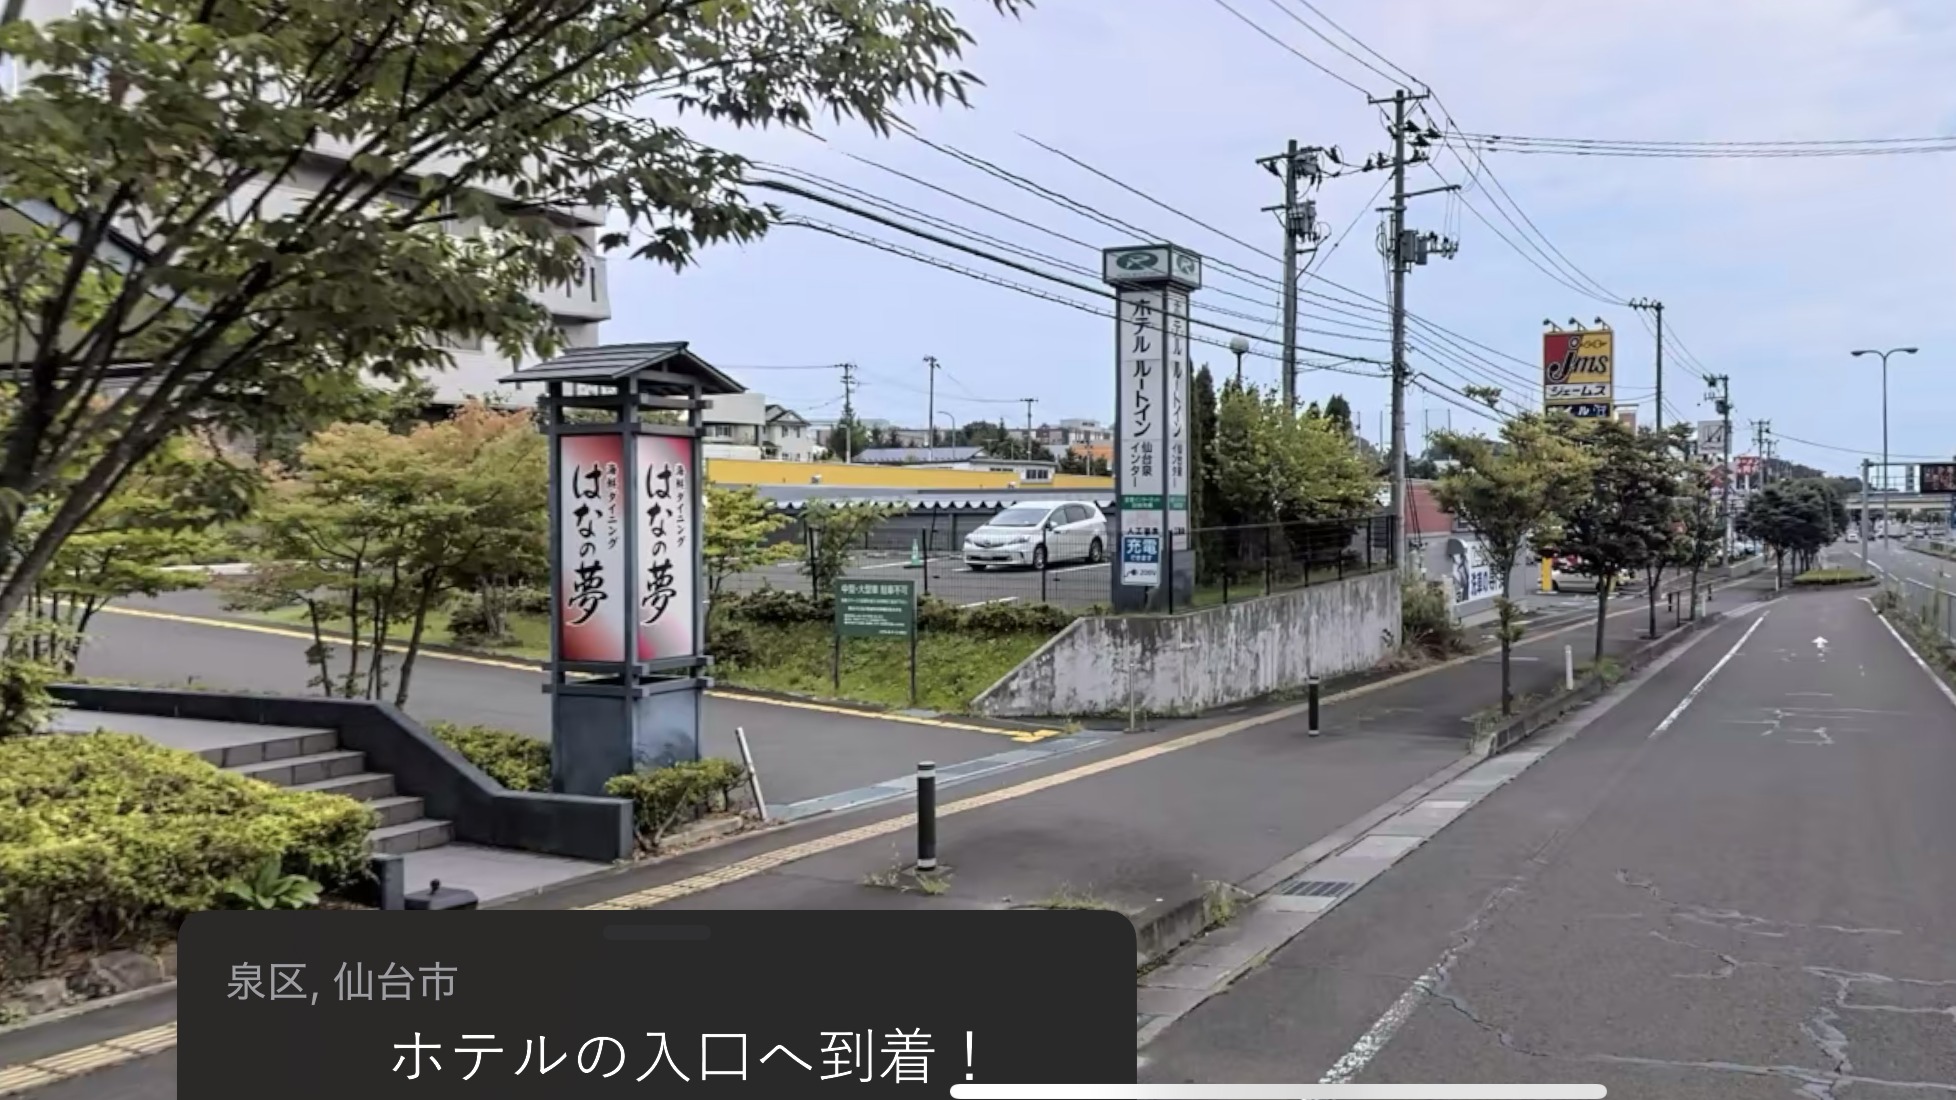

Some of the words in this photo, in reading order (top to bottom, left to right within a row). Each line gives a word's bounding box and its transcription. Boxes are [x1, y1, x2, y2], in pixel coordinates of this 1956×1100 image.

[1133, 360, 1152, 437] ルートイン
[1549, 385, 1606, 396] ジェームス
[1131, 442, 1140, 487] インター
[568, 464, 608, 624] はなの夢
[642, 463, 677, 623] はなの夢
[1126, 538, 1157, 555] 充電
